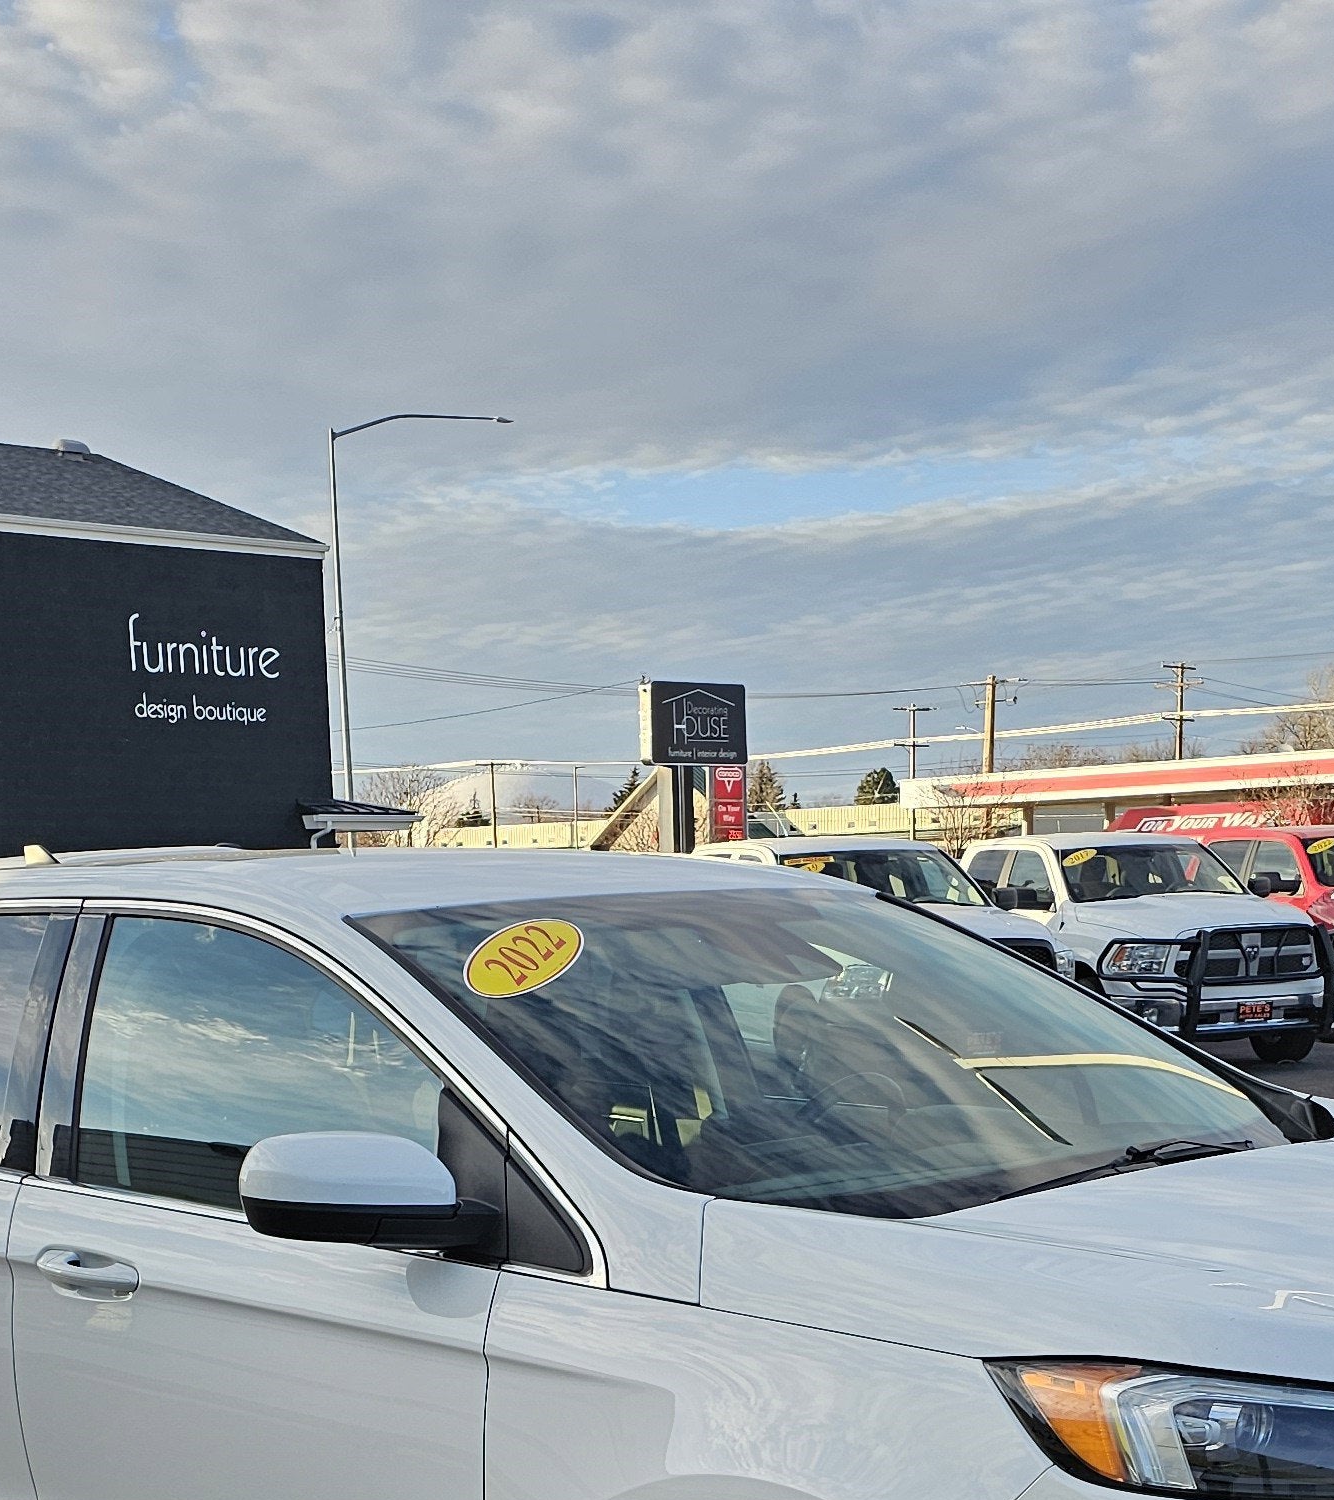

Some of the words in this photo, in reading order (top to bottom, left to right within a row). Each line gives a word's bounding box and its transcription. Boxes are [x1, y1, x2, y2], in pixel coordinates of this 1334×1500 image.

[128, 612, 280, 679] furniture
[134, 691, 187, 724] design
[192, 694, 267, 726] boutique
[687, 701, 728, 716] Decorating
[718, 748, 738, 760] design
[717, 804, 727, 812] On
[727, 804, 741, 812] Your
[1068, 850, 1089, 865] 2017
[485, 926, 566, 987] 2022
[1239, 1004, 1271, 1014] PETE'S
